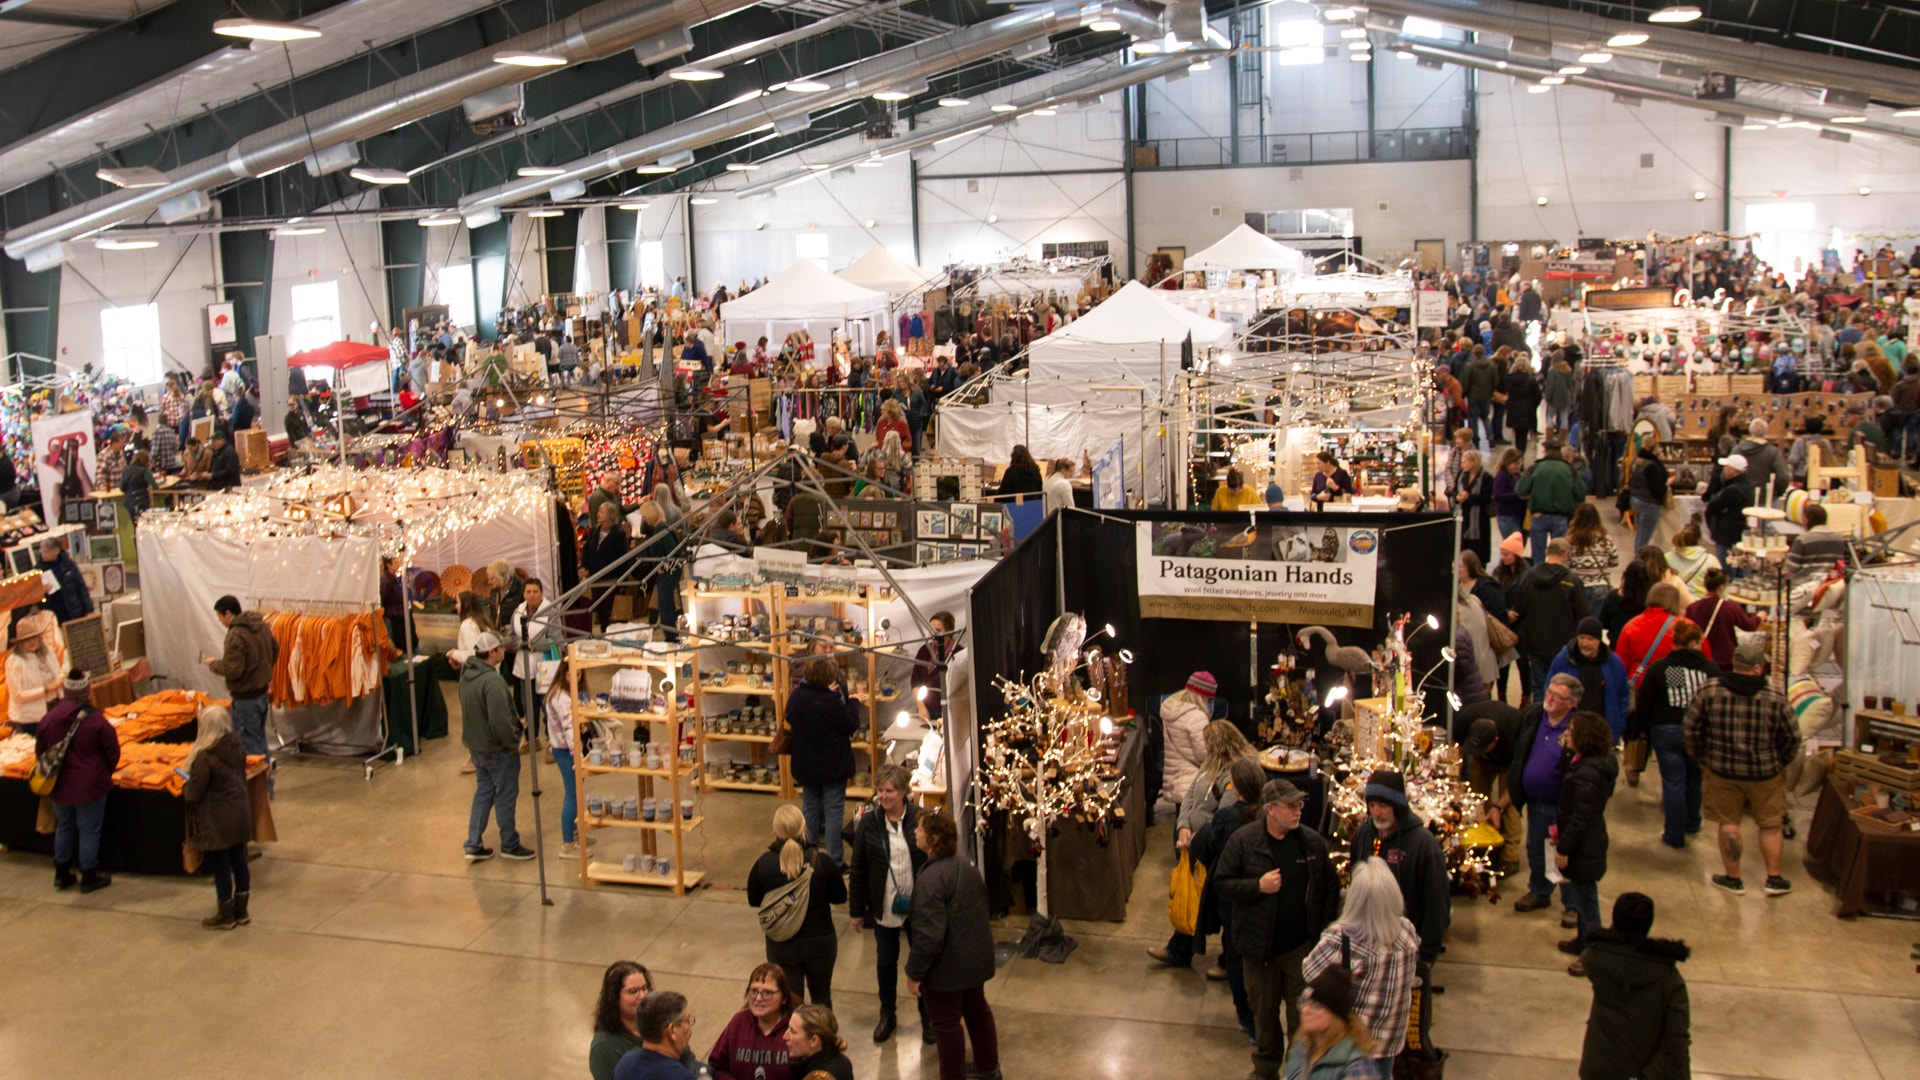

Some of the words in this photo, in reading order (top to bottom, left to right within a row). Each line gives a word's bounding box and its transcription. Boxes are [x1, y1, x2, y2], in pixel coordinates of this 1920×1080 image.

[1159, 559, 1277, 585] Patagonian
[1285, 565, 1353, 586] Hands
[1183, 586, 1202, 595] Wool
[1203, 586, 1224, 596] felted
[1225, 587, 1264, 598] sculptures,
[1265, 590, 1292, 600] jewelry
[1294, 590, 1307, 599] and
[1148, 599, 1280, 615] www.patagonianhands.com
[1299, 605, 1346, 617] Missoula,
[1347, 608, 1362, 617] MT
[1407, 990, 1422, 1050] STEELERS
